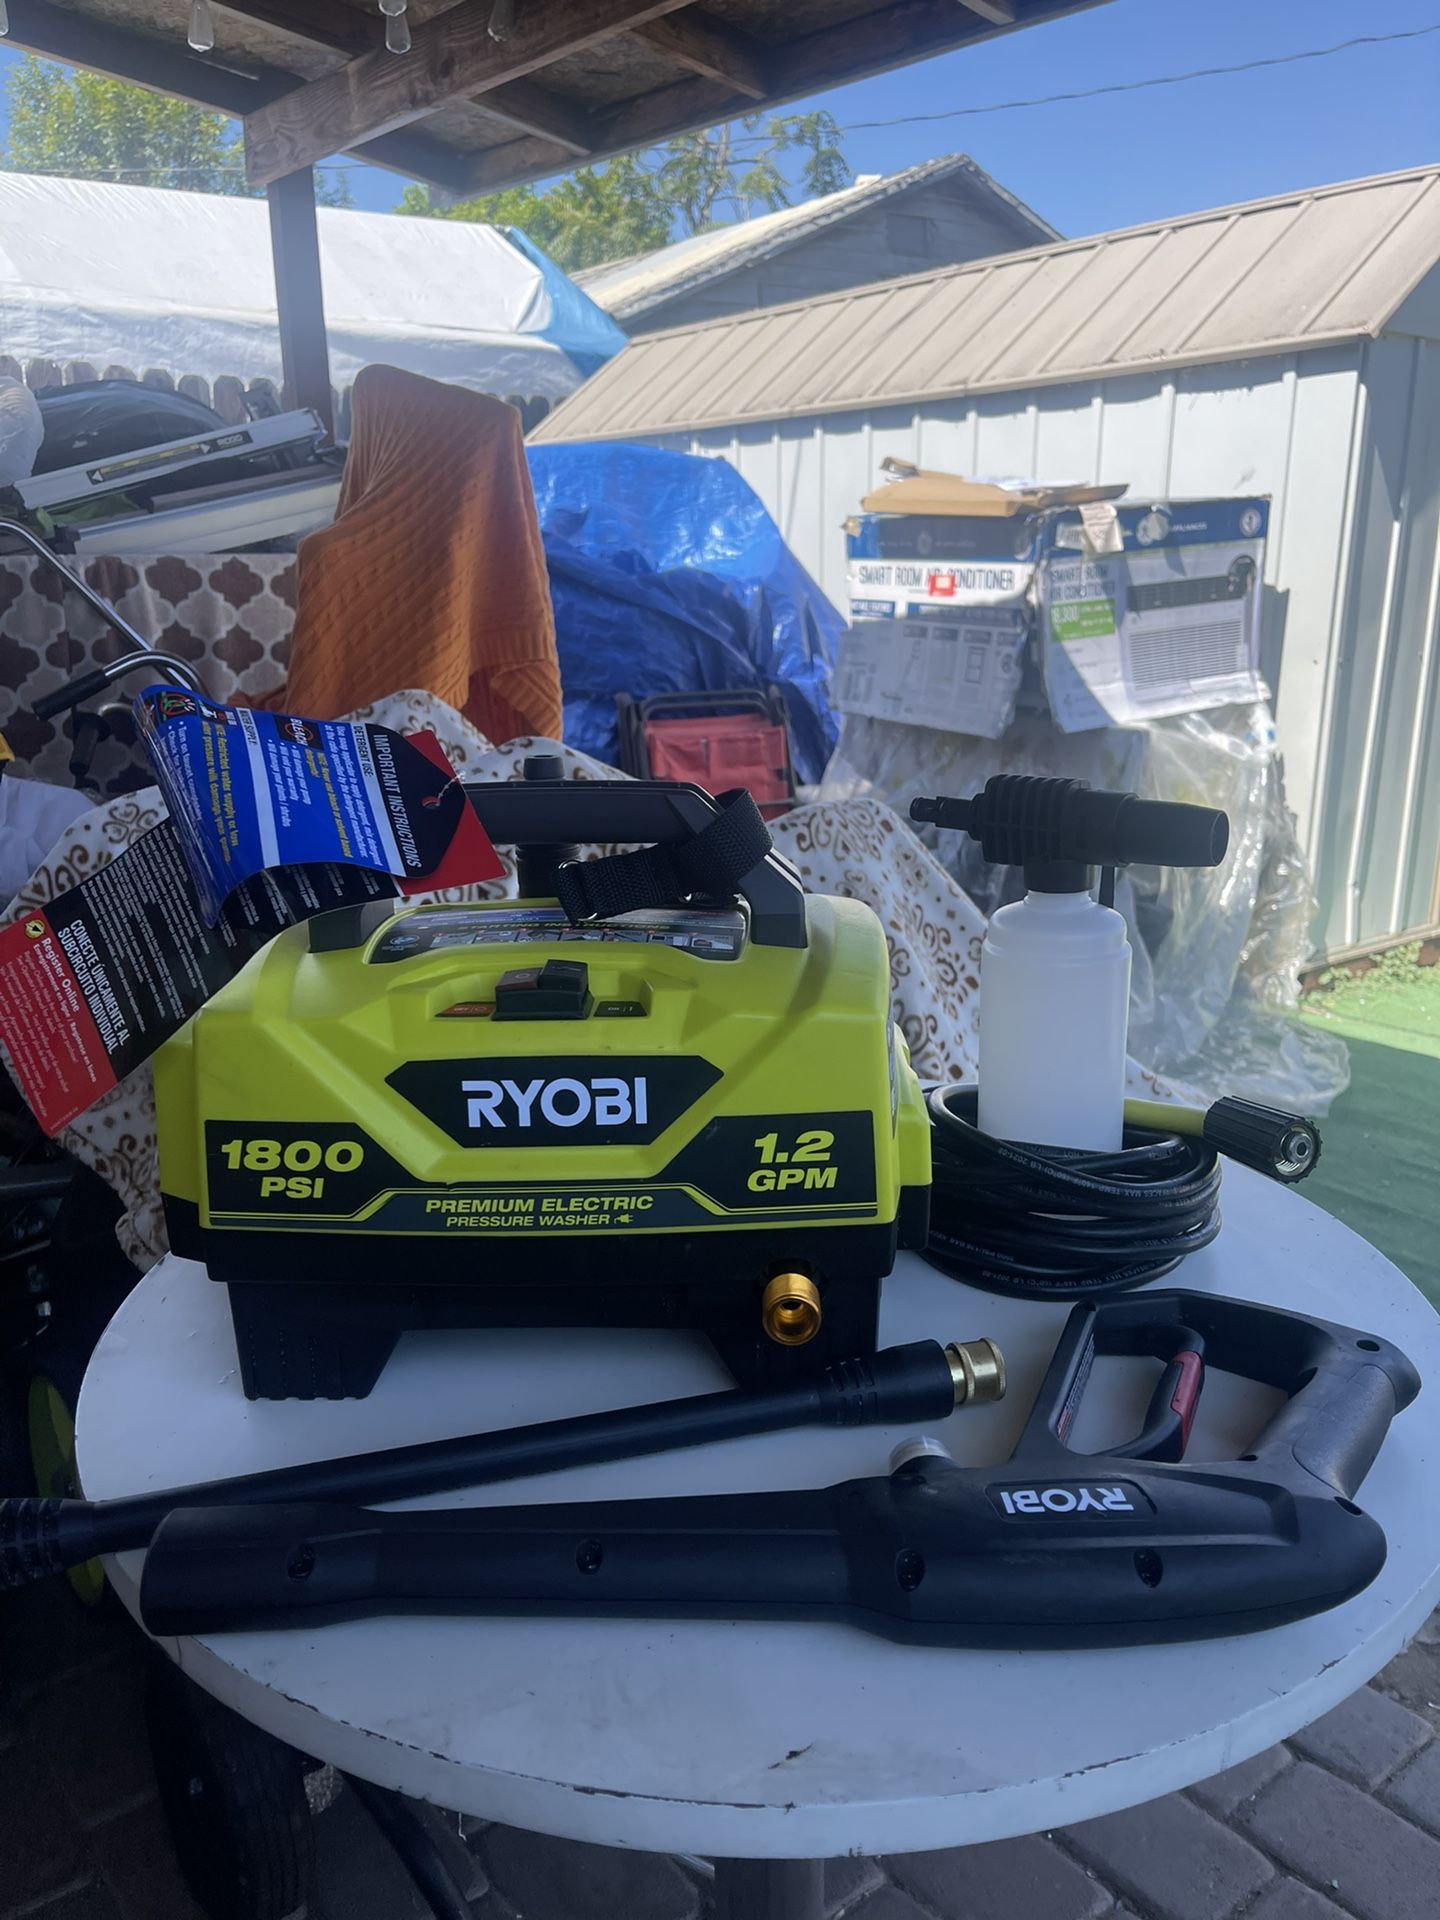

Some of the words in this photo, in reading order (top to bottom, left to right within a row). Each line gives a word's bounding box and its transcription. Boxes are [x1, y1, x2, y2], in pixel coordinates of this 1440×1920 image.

[859, 566, 893, 584] SMART
[895, 567, 922, 586] ROOM
[167, 730, 178, 755] Check
[177, 727, 186, 742] Turn
[290, 718, 307, 745] BLEACH
[353, 726, 370, 761] DETERGENT
[180, 743, 188, 753] on
[202, 736, 214, 766] pressure
[216, 737, 229, 769] Restricted
[182, 752, 193, 778] faucet
[208, 767, 216, 781] will
[220, 771, 230, 790] water
[208, 782, 220, 814] damage
[223, 793, 234, 818] supply
[373, 734, 400, 792] IMPORTANT
[387, 795, 422, 866] INSTRUCTIONS
[214, 816, 225, 834] your
[280, 807, 291, 826] shrubs
[229, 829, 238, 846] low
[31, 943, 60, 992] Enregistrement
[39, 937, 66, 979] Register
[60, 977, 81, 1012] Online
[56, 927, 97, 995] SUBCIRCUITO
[86, 993, 121, 1054] INDIVIDUAL
[68, 918, 100, 967] CONECTE
[90, 962, 126, 1030] ÚNICAMENTE
[117, 1028, 132, 1046] AL
[55, 991, 63, 1001] en
[58, 999, 70, 1018] ligne
[82, 1055, 90, 1066] en
[462, 1077, 648, 1127] RYOBI
[221, 1139, 364, 1172] 1800
[754, 1130, 834, 1163] 1.2
[260, 1176, 325, 1198] PSI
[747, 1167, 838, 1191] GPM
[425, 1199, 534, 1213] PREMIUM
[541, 1195, 654, 1212] ELECTRIC
[446, 1215, 534, 1227] PRESSURE
[539, 1214, 610, 1226] WASHER
[1000, 1488, 1134, 1513] RYOBI
